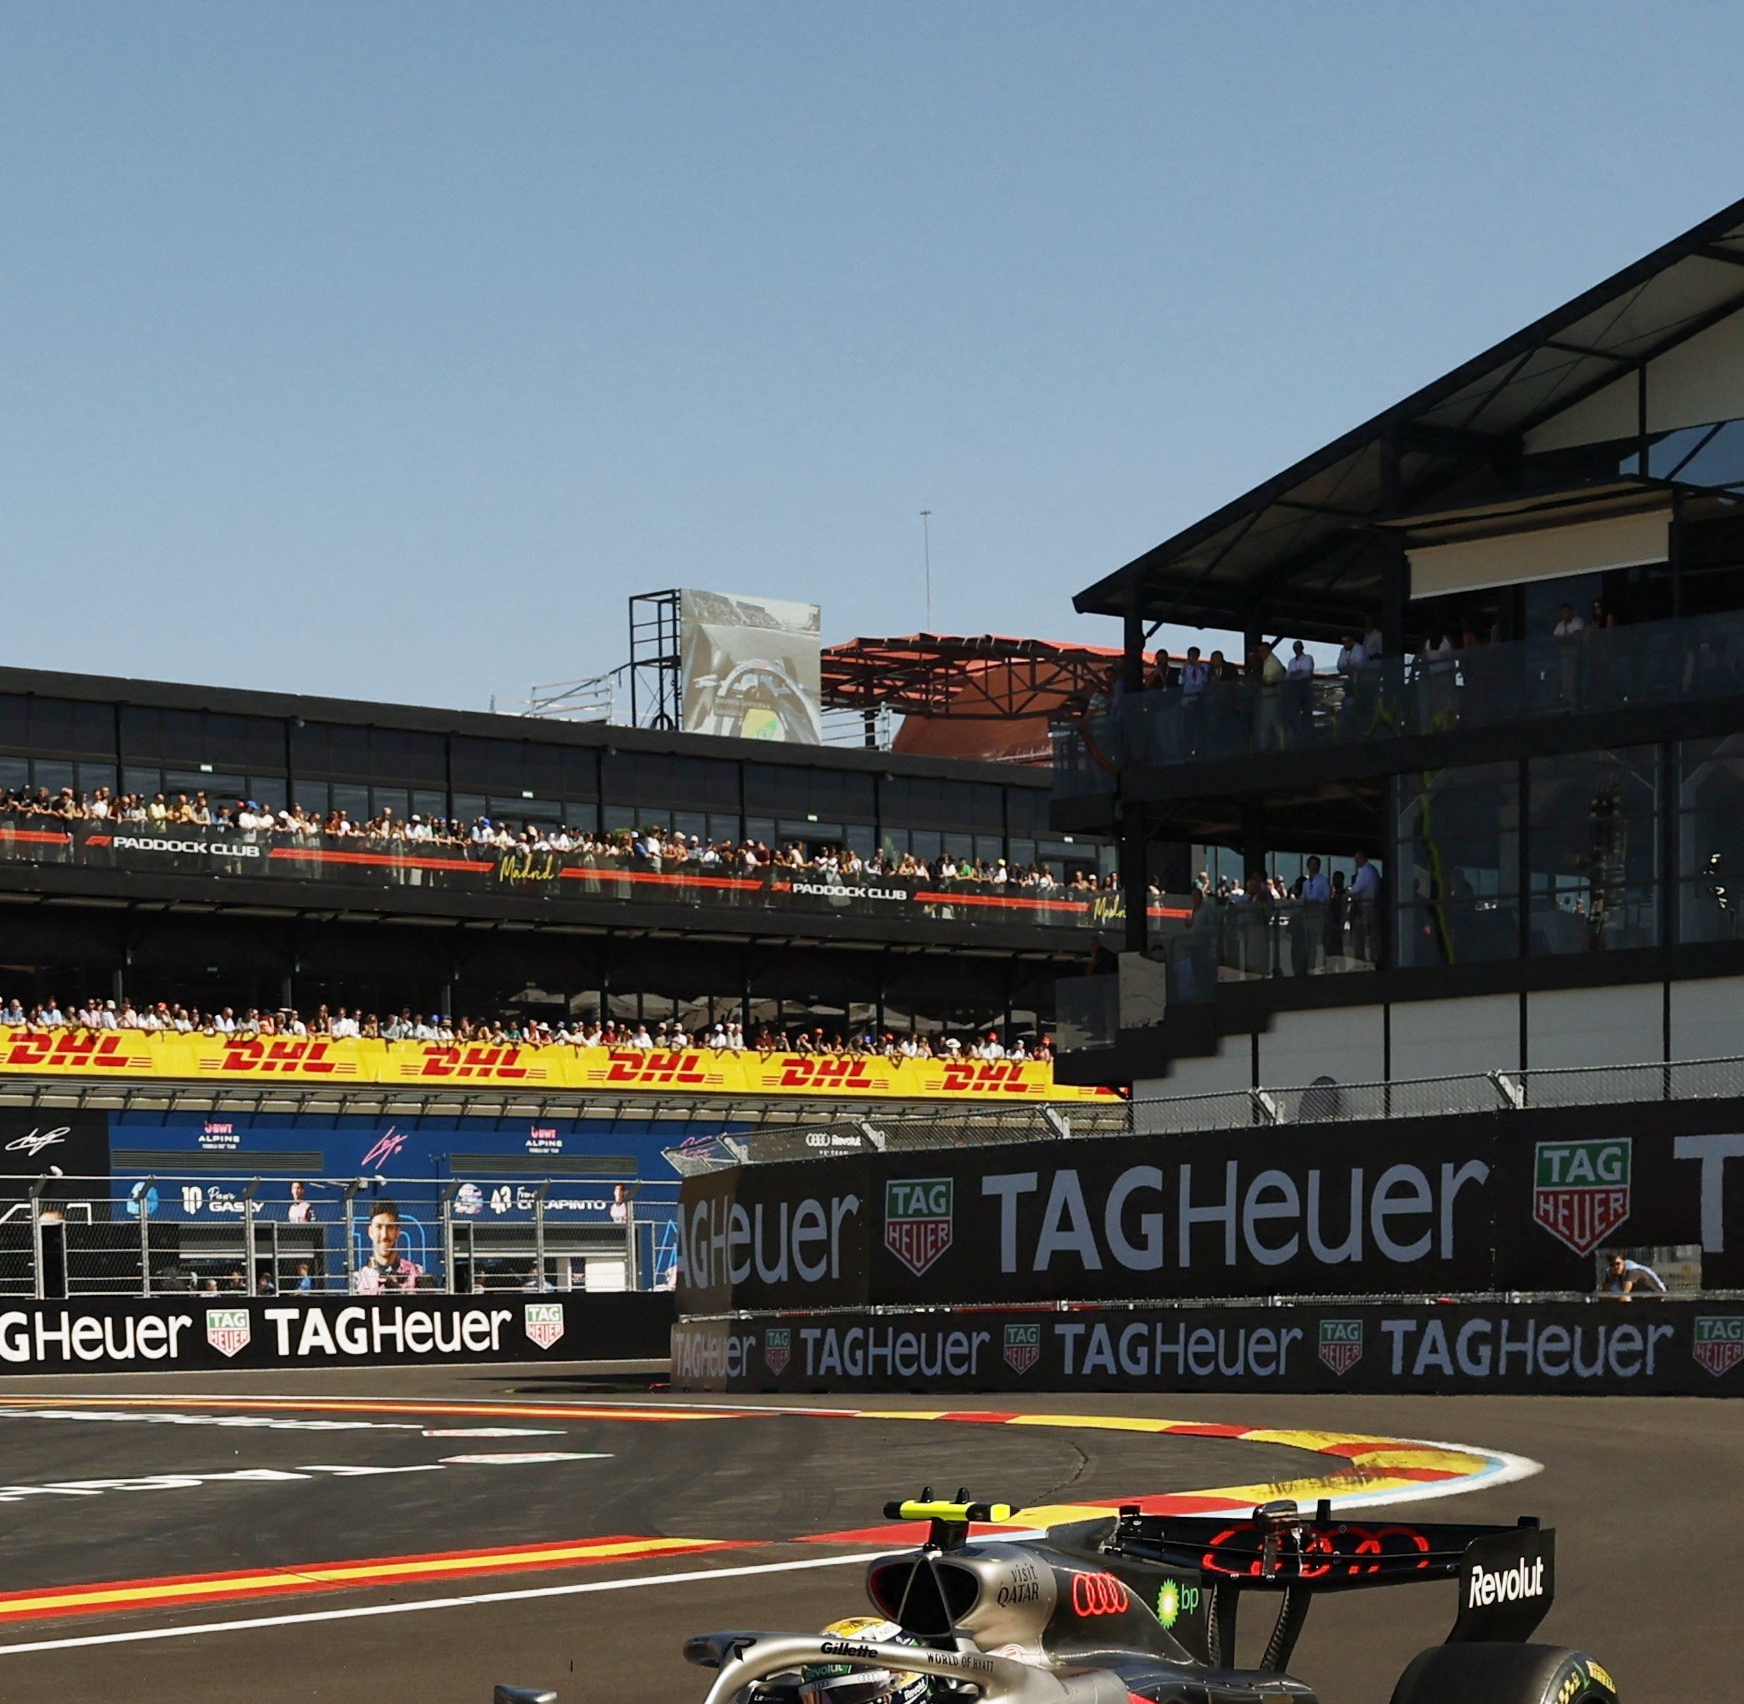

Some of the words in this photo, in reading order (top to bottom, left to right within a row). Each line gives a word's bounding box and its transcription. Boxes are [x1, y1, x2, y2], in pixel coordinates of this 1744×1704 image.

[113, 836, 208, 855] PADDOCK
[211, 842, 260, 858] CLUB
[499, 855, 555, 883] Madrid
[792, 882, 865, 899] PADDOCK
[868, 887, 907, 901] CLUB
[6, 1032, 130, 1068] DHL
[222, 1040, 337, 1074] DHL
[420, 1047, 528, 1079] DHL
[606, 1052, 707, 1084] DHL
[779, 1059, 874, 1089] DHL
[941, 1063, 1029, 1093] DHL
[198, 1135, 241, 1144] ALPINE
[525, 1139, 563, 1148] ALPINE
[1542, 1145, 1623, 1183] TAG
[181, 1186, 203, 1216] 10
[208, 1201, 265, 1214] GASY
[516, 1200, 607, 1212] COAPINTO
[891, 1183, 947, 1215] TAG
[981, 1159, 1490, 1274] TAGHeuer
[1539, 1190, 1625, 1250] HEUER
[889, 1220, 951, 1269] HEUER
[210, 1313, 247, 1329] TAG
[529, 1306, 562, 1321] TAG
[209, 1329, 249, 1353] HEUER
[264, 1307, 513, 1357] TAGHeuer
[527, 1323, 562, 1345] HEUER
[768, 1331, 790, 1346] TAG
[1008, 1326, 1039, 1344] TAG
[1323, 1322, 1361, 1341] TAG
[1697, 1318, 1744, 1340] TAG
[675, 1325, 757, 1378] TAGHeuer
[800, 1326, 991, 1377] TAGHeuer
[1005, 1345, 1039, 1371] HEUER
[1054, 1321, 1303, 1376] TAGHeuer
[1320, 1343, 1362, 1372] HEUER
[1380, 1317, 1674, 1380] TAGHeuer
[1012, 1562, 1038, 1584] visit
[1468, 1555, 1545, 1610] Revolut
[997, 1581, 1040, 1608] QATAR
[1180, 1583, 1200, 1613] bp
[820, 1641, 879, 1659] Gillette
[926, 1652, 959, 1668] WORLD
[961, 1657, 973, 1669] OF
[973, 1659, 995, 1673] HYATT
